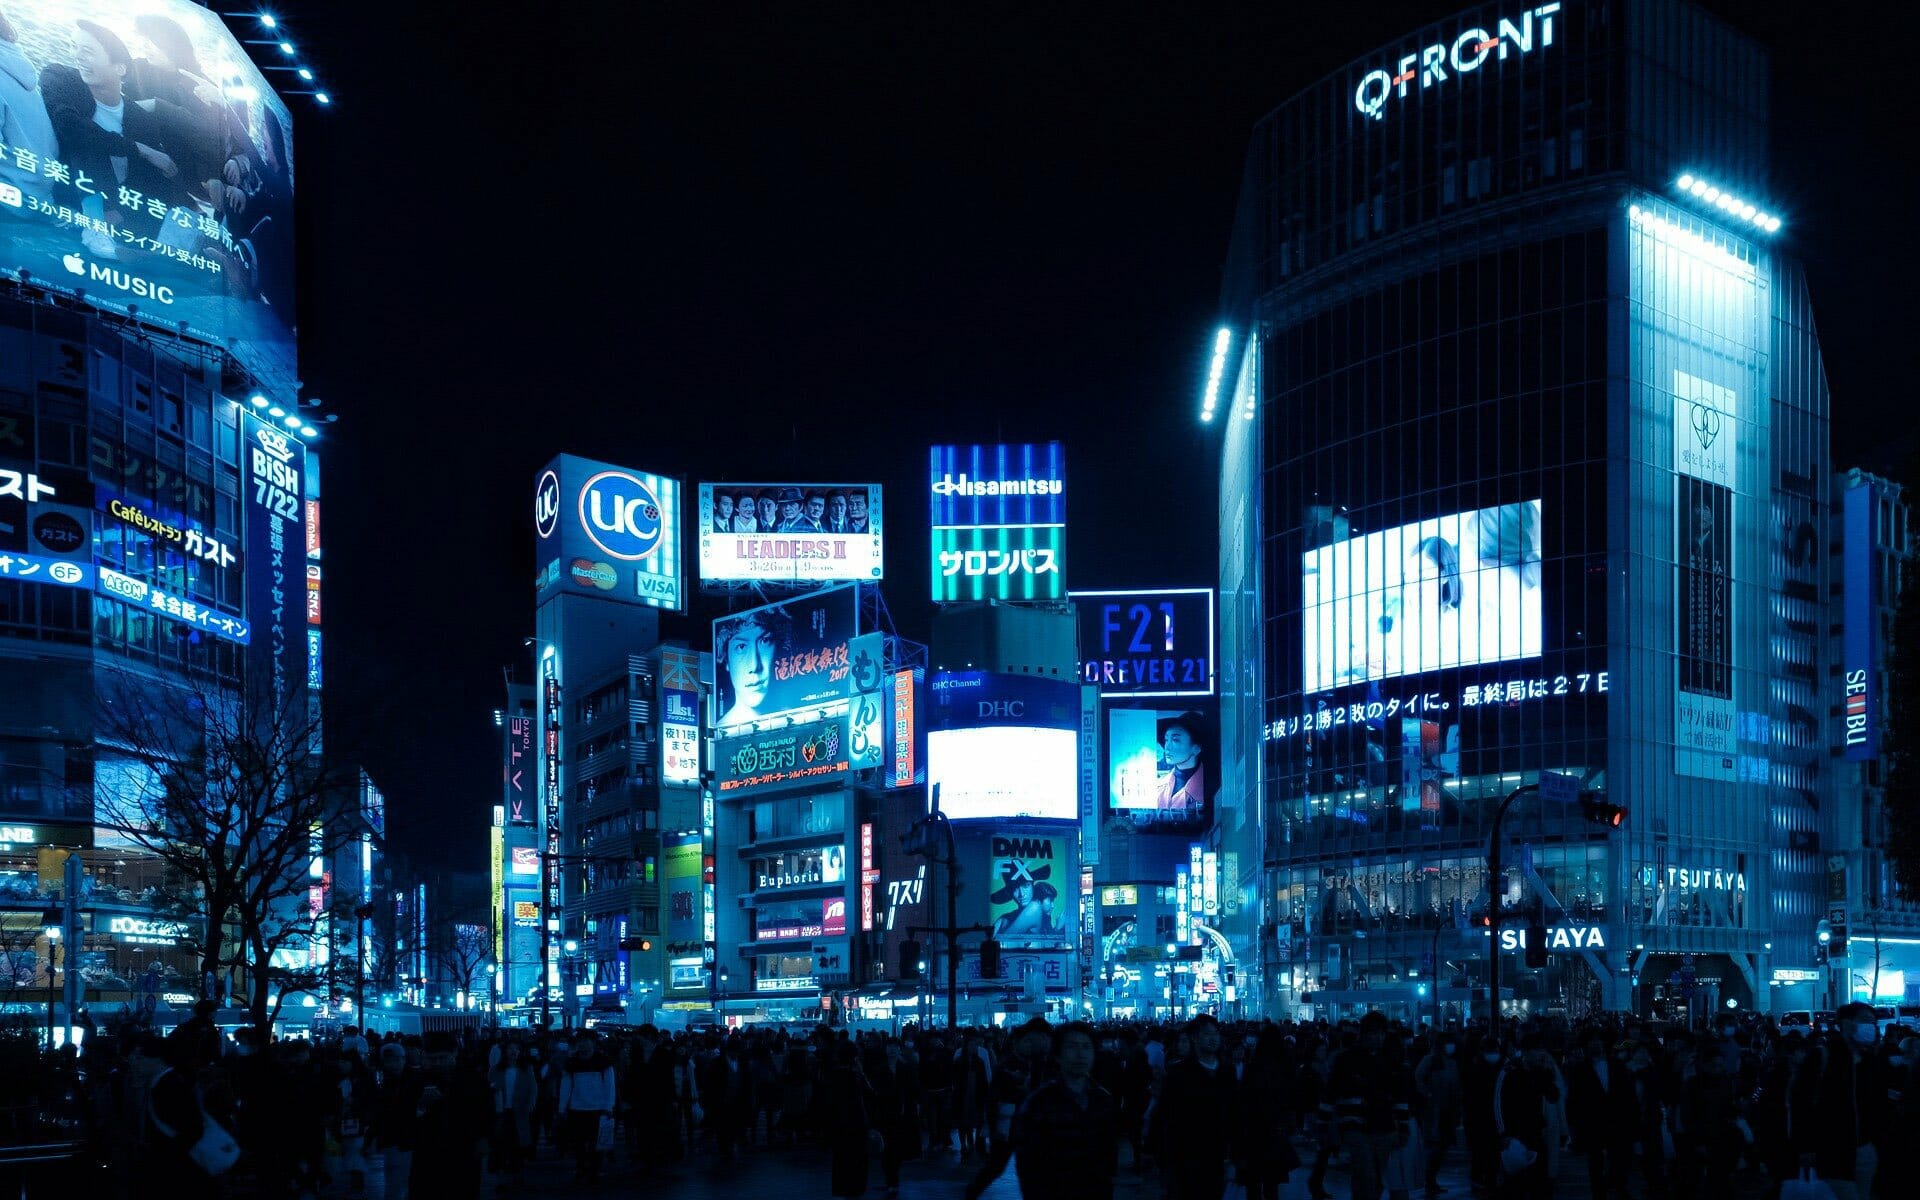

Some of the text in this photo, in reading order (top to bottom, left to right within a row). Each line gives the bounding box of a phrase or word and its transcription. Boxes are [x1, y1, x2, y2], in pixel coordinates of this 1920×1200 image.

[1355, 2, 1560, 120] QFRONT
[27, 196, 221, 274] 3か月無料トライアル受付中
[91, 262, 174, 305] MUSIC
[252, 447, 298, 496] BiSH
[931, 473, 1062, 496] Hisamitsu
[253, 477, 299, 523] 7/22
[184, 529, 236, 568] ガスト
[736, 540, 830, 559] LEADERS
[55, 566, 78, 580] 6F
[939, 549, 1059, 576] サロンパス
[105, 575, 143, 599] AEON
[642, 578, 675, 596] VISA
[1103, 602, 1174, 652] F21
[829, 667, 849, 682] 2017
[1077, 658, 1205, 684] OREVER 21
[932, 678, 981, 690] DHC Channel
[978, 700, 1024, 718] DHC
[1846, 669, 1867, 746] SEIBU
[759, 746, 796, 770] 西村
[992, 837, 1053, 859] DMM
[759, 870, 819, 888] Euphoria
[993, 859, 1033, 881] FX
